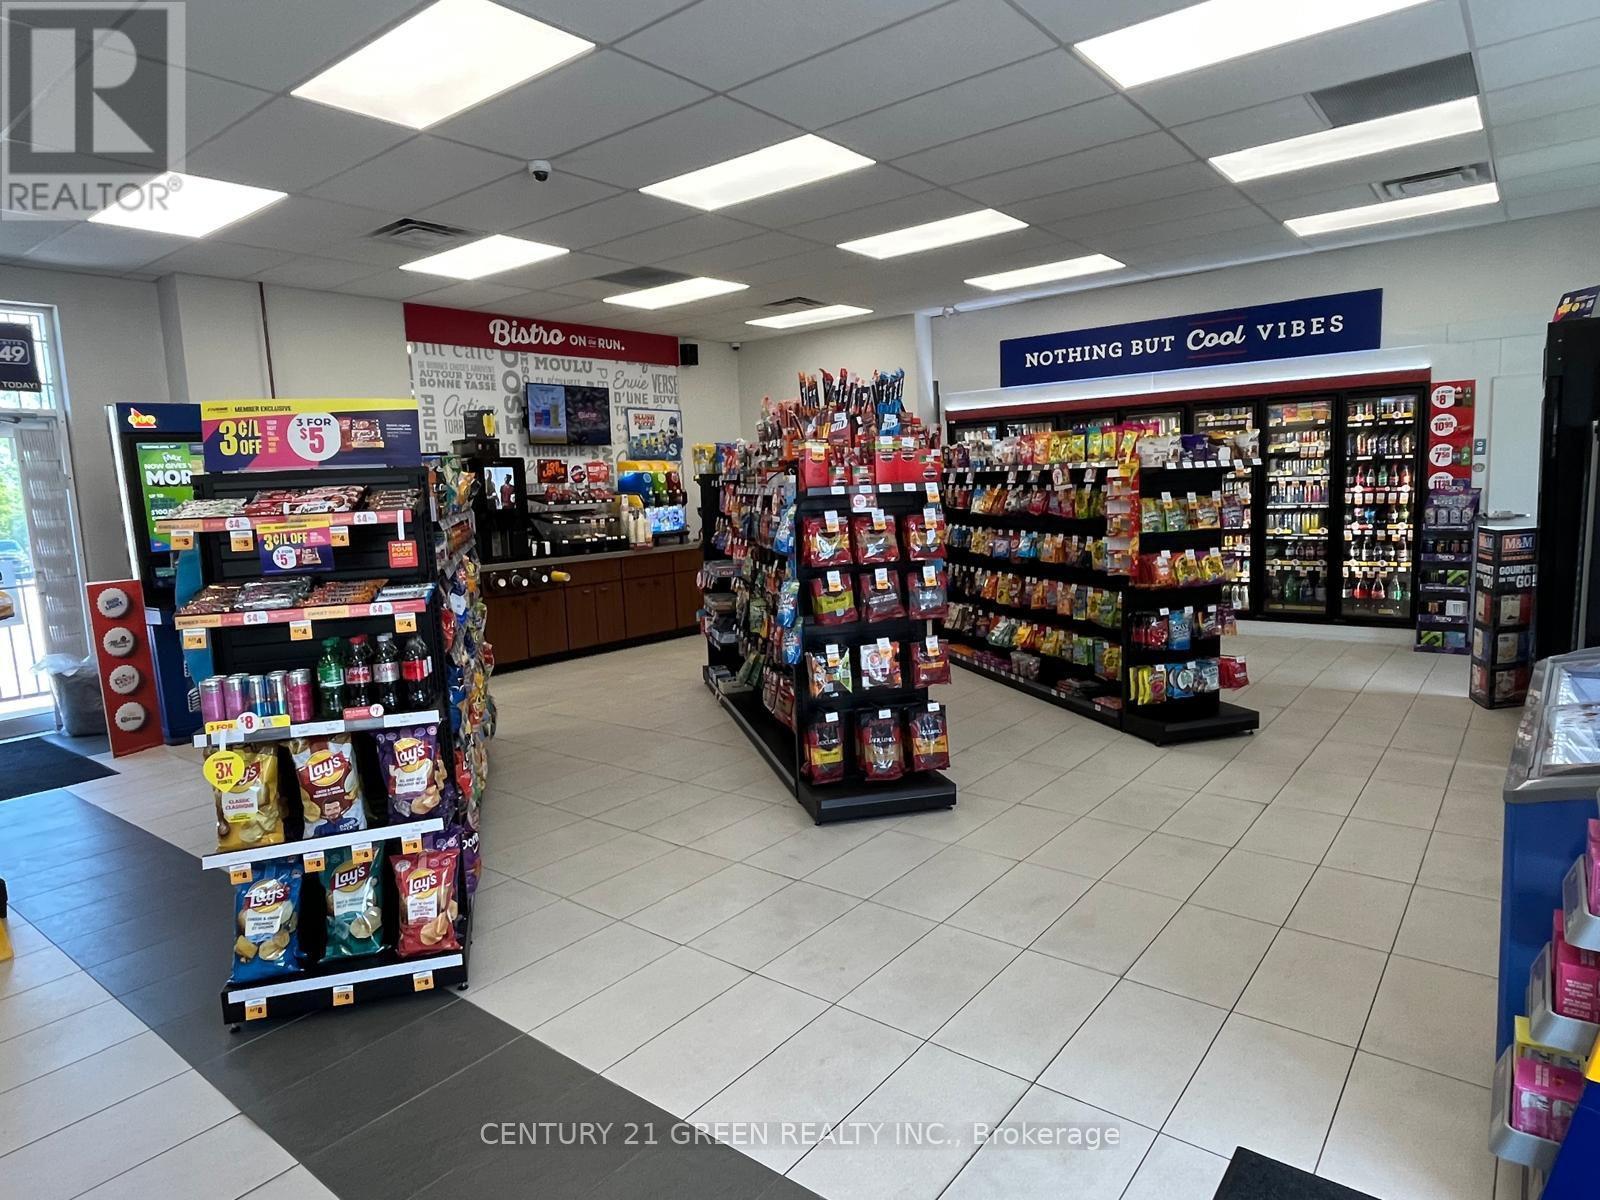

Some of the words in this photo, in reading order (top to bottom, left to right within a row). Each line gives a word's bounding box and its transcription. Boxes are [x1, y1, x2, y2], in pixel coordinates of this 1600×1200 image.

[488, 318, 566, 346] Bistro
[569, 334, 587, 347] ON
[598, 337, 625, 351] RUN.
[1025, 342, 1124, 368] NOTHING
[1131, 335, 1176, 356] BUT
[1186, 324, 1246, 352] Cool
[1257, 314, 1345, 342] VIBES
[534, 357, 593, 374] MOULU
[419, 369, 463, 379] AUTOUR
[465, 371, 496, 382] D'UNE
[613, 369, 650, 391] Envie
[1, 380, 38, 390] TODAY!
[419, 378, 461, 390] BONNE
[463, 380, 497, 392] TASSE
[614, 391, 649, 405] D'UNE
[259, 404, 292, 412] EXCLUSIVE
[296, 418, 304, 427] 3
[306, 417, 332, 427] FOR
[420, 394, 439, 453] PAUSE
[239, 440, 263, 456] OFF
[299, 426, 326, 454] $5
[145, 469, 193, 487] MOR
[290, 532, 308, 544] OFF
[1505, 536, 1533, 550] M&M
[1499, 564, 1537, 576] GOURMET
[1516, 574, 1537, 588] GO!
[216, 722, 234, 731] FOR
[239, 714, 254, 730] $8
[396, 743, 426, 767] Lay's
[215, 762, 233, 780] 3X
[308, 756, 342, 782] Lay's
[225, 803, 254, 811] CLASSIQUE
[228, 797, 250, 805] CLASSIC
[334, 865, 366, 889] Lay's
[408, 873, 438, 895] Lay's
[249, 888, 285, 908] Lay's
